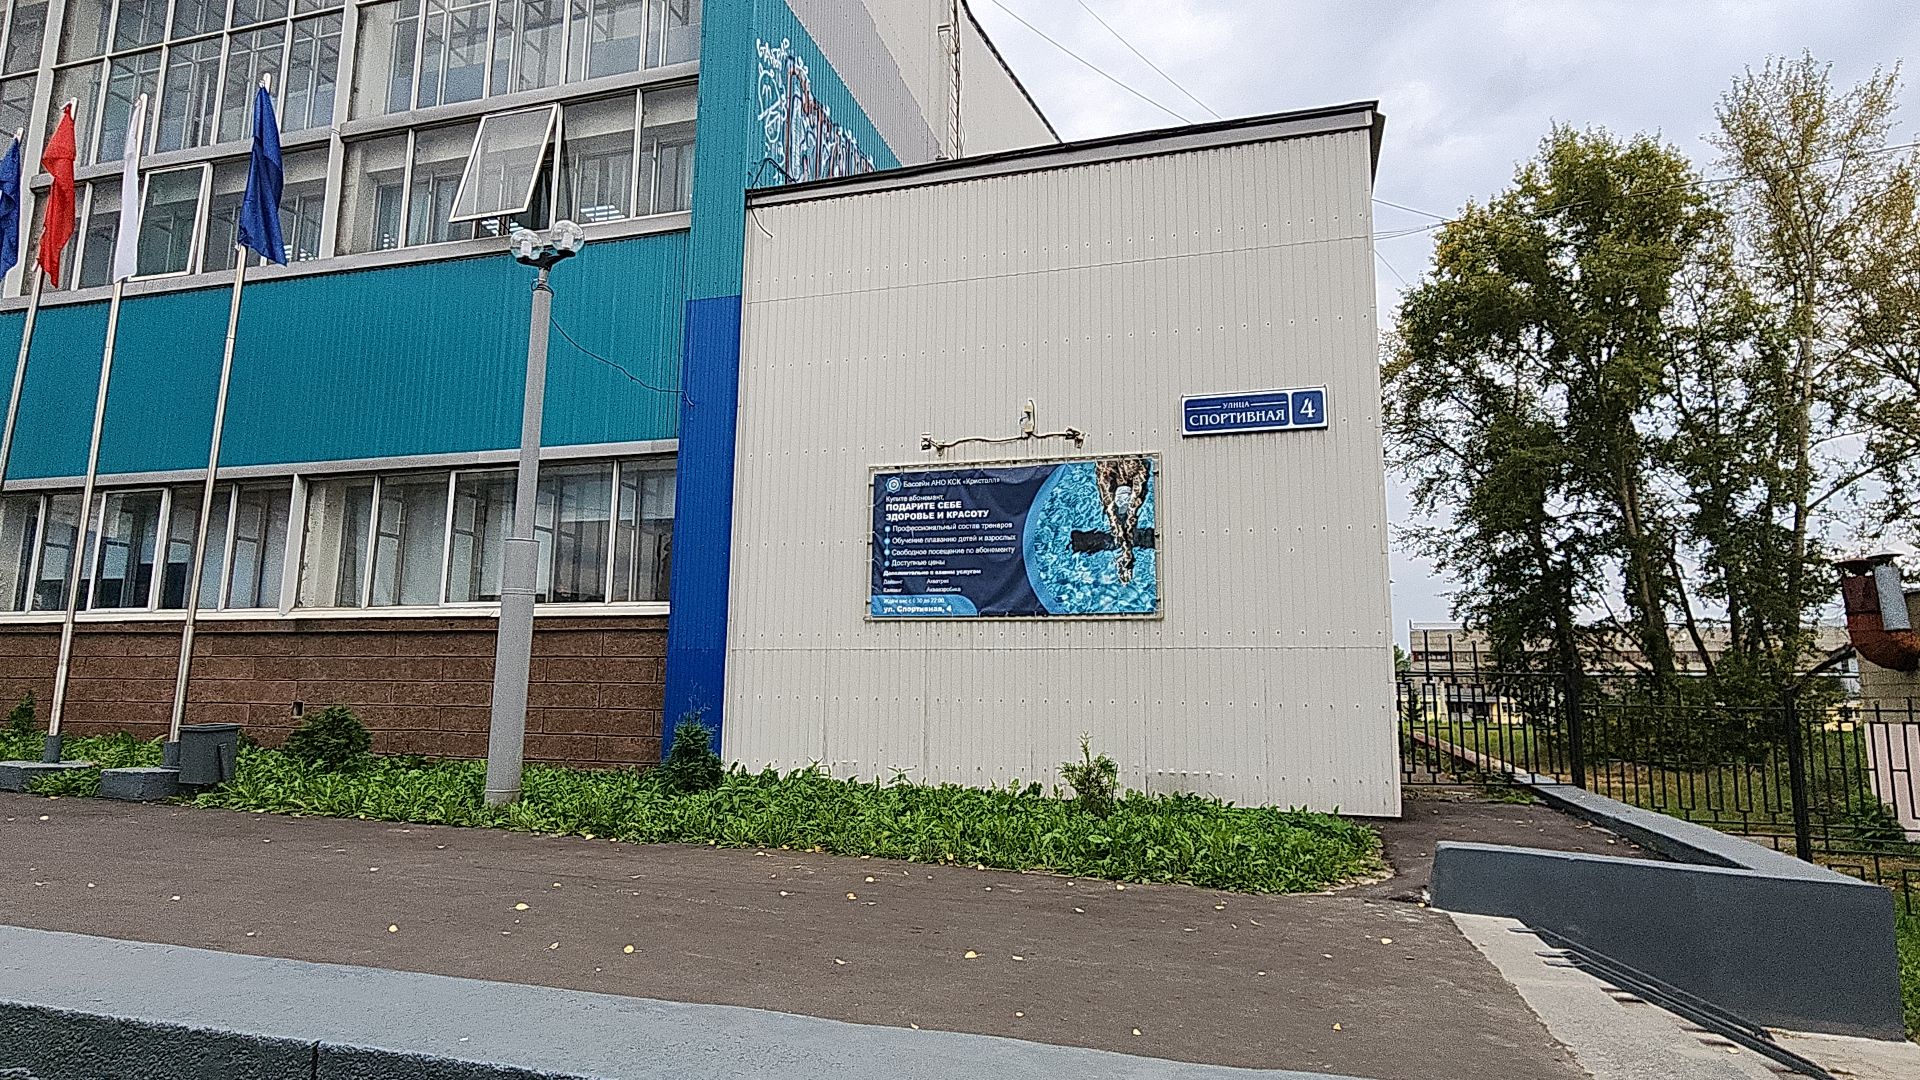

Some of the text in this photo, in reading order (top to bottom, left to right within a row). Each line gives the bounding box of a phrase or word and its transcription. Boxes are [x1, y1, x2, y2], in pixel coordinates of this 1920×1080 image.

[1222, 401, 1250, 409] УЛИЦА
[1299, 397, 1316, 418] 4
[1189, 409, 1285, 426] СПОРТИВНАЯ
[903, 479, 930, 488] Бассейн
[885, 495, 908, 503] Купите
[885, 501, 962, 512] ПОДАРИТЕ СЕБЕ
[885, 510, 990, 521] ЗДОРОВЬЕ И КРАСОТУ
[892, 523, 957, 532] Профессиональный
[981, 522, 1013, 530] тренеров
[891, 537, 923, 545] Обучение
[958, 535, 977, 543] детей
[891, 548, 927, 556] Свободное
[975, 546, 1016, 554] абонементу
[891, 559, 927, 567] Доступные
[896, 605, 945, 613] Спортивная,
